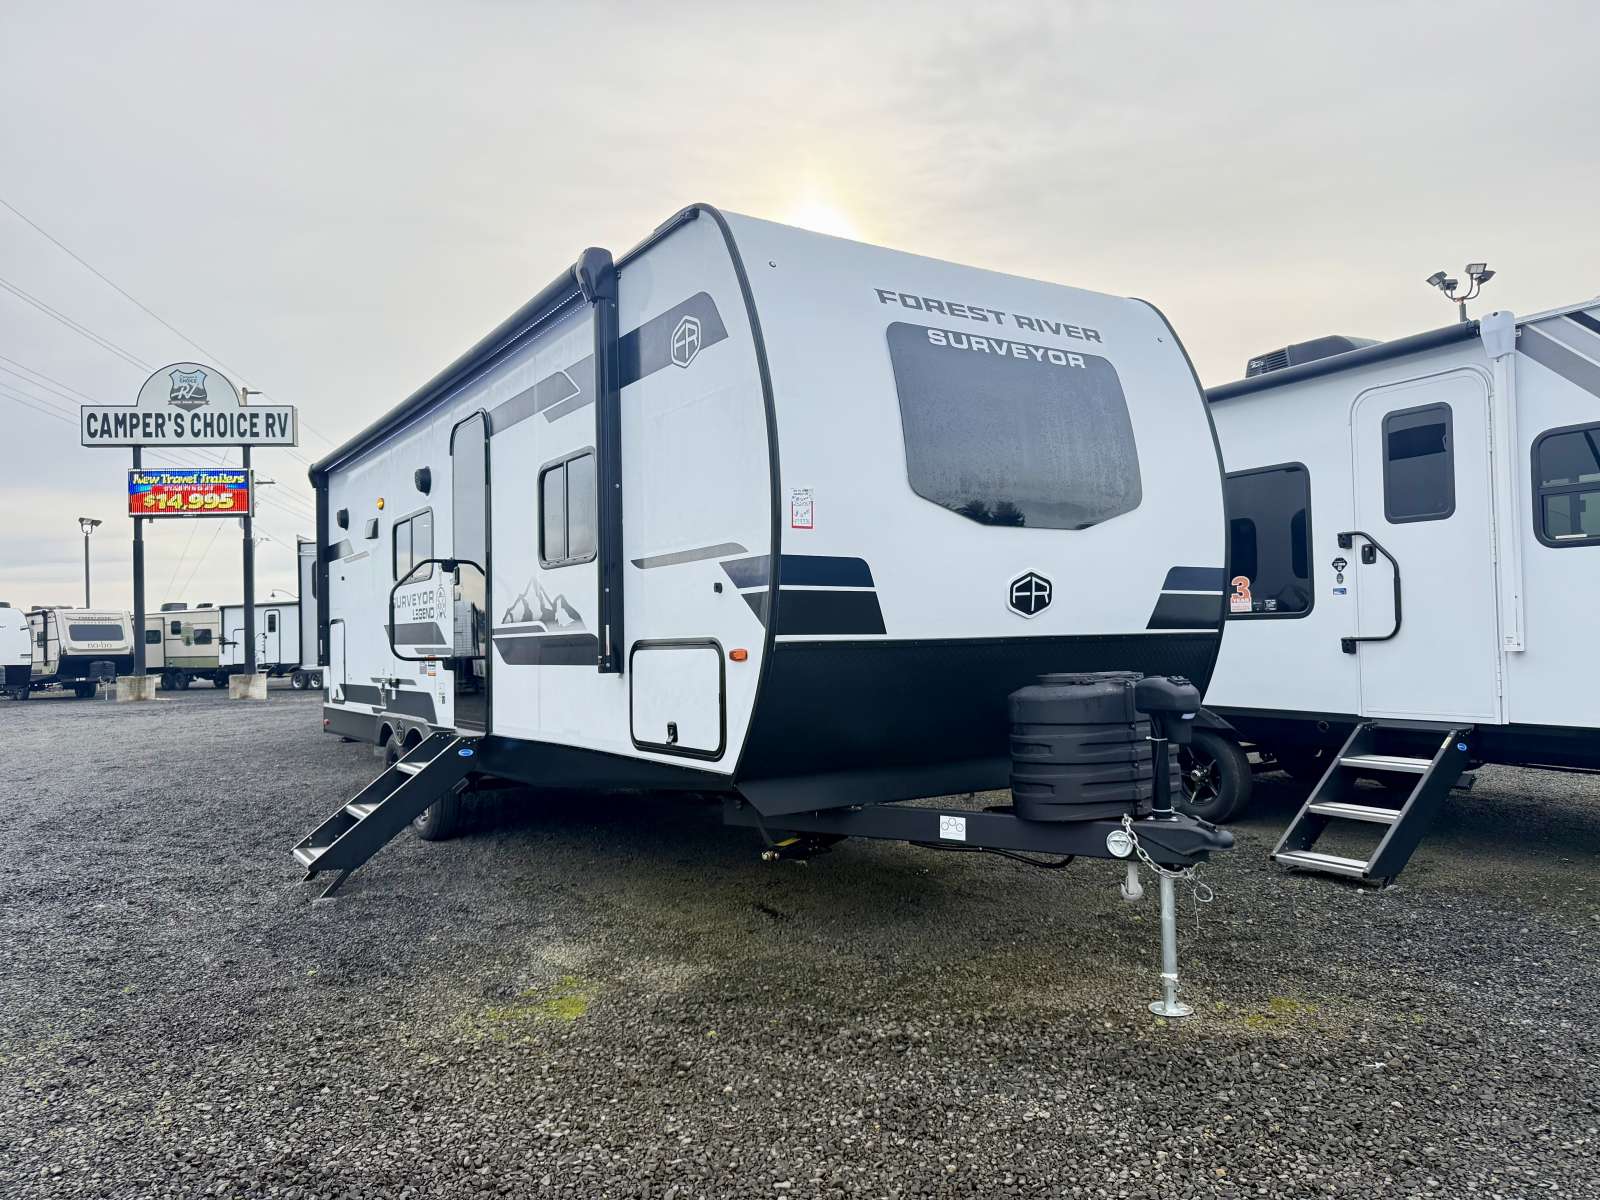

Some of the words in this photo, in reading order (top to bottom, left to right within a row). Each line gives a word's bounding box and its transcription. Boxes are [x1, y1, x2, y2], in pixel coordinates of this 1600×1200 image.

[874, 288, 1006, 324] FOREST
[1013, 313, 1103, 343] RIVER
[927, 329, 1086, 368] SURVEYOR
[86, 412, 185, 438] CAMPER'S
[190, 412, 260, 438] CHOICE
[265, 412, 289, 438] RV
[133, 474, 159, 484] New
[161, 473, 198, 484] Travel
[200, 473, 245, 484] Trailers
[144, 493, 234, 510] $14,995
[1231, 576, 1250, 598] 3
[412, 607, 434, 620] LEGEND
